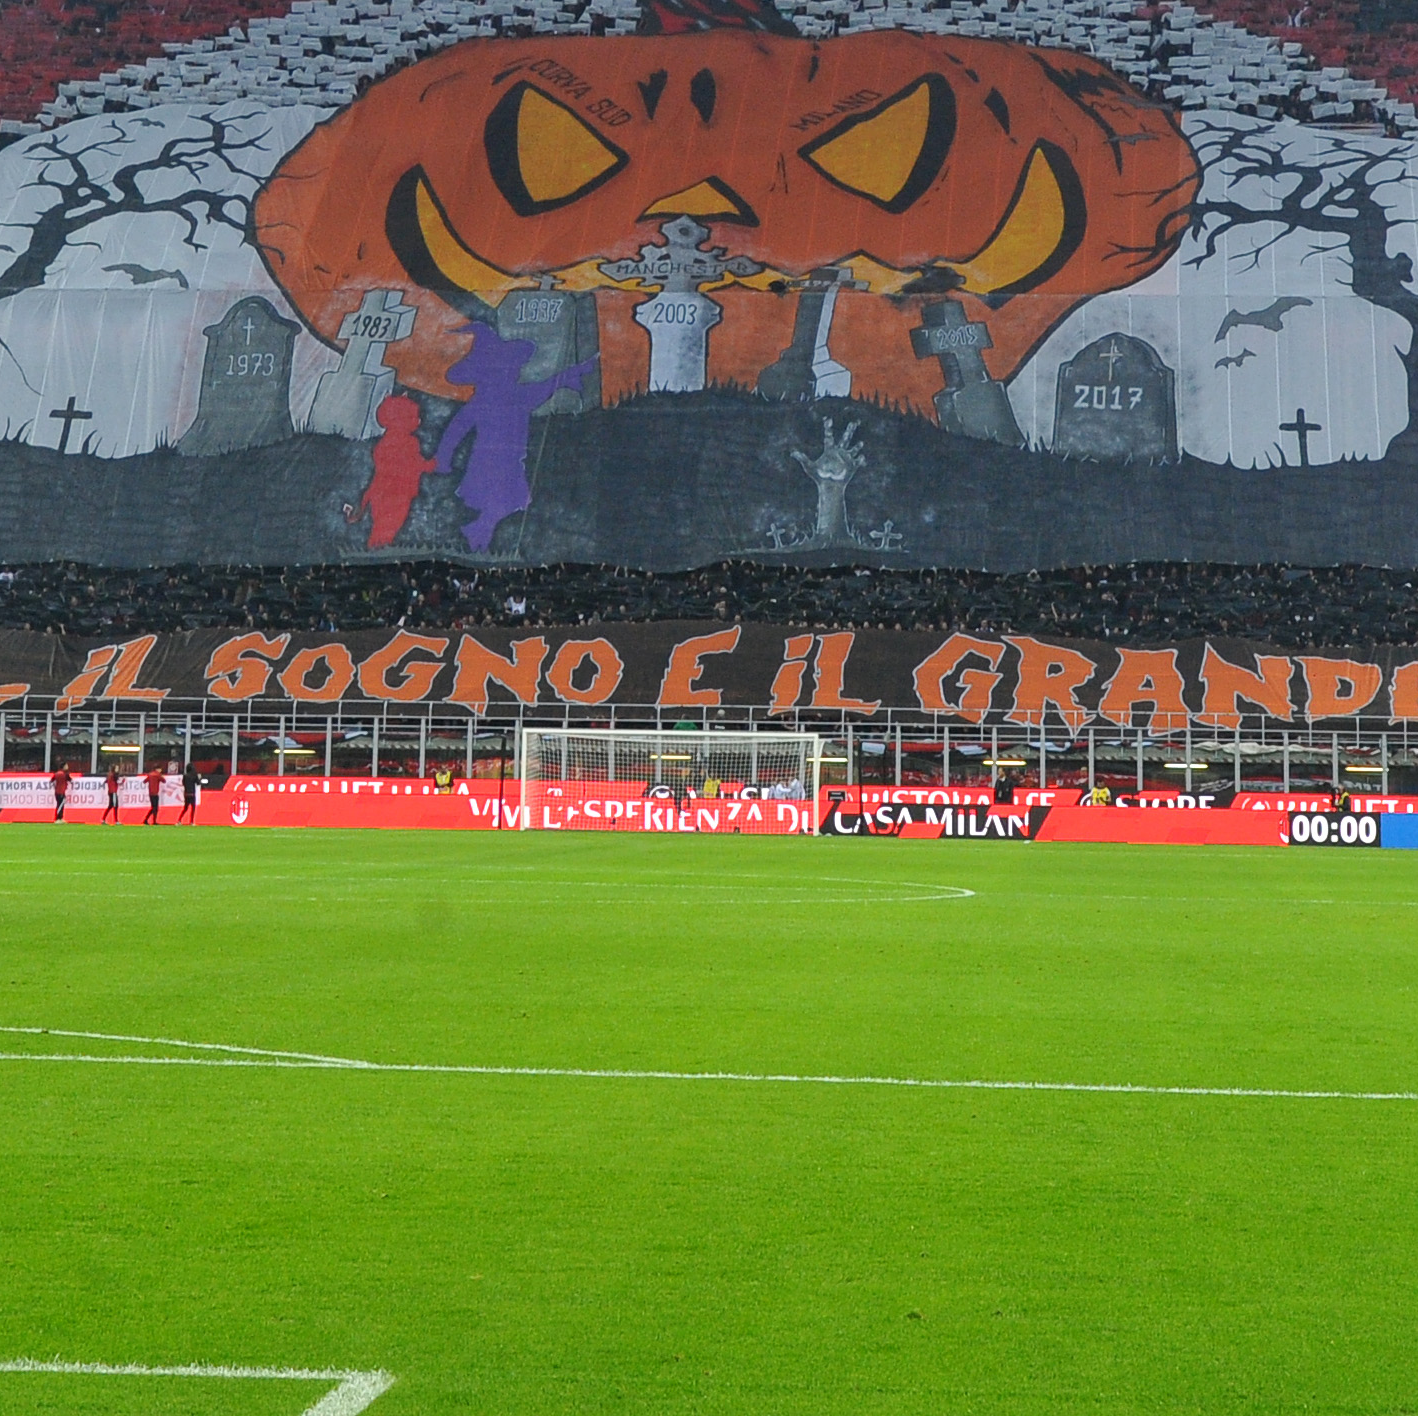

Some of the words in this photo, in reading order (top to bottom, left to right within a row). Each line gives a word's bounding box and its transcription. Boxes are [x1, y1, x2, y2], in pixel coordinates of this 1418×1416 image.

[530, 59, 592, 99] CURVA
[586, 98, 632, 126] SUD
[616, 261, 748, 275] MANCHESTER
[515, 298, 564, 324] 1997
[653, 302, 698, 325] 2003
[351, 314, 392, 338] 1983
[936, 325, 978, 350] 2015
[226, 353, 274, 376] 1973
[1074, 385, 1144, 410] 2017
[203, 630, 626, 717] SOGNO
[657, 624, 742, 709] E
[1291, 815, 1376, 844] 00:00
